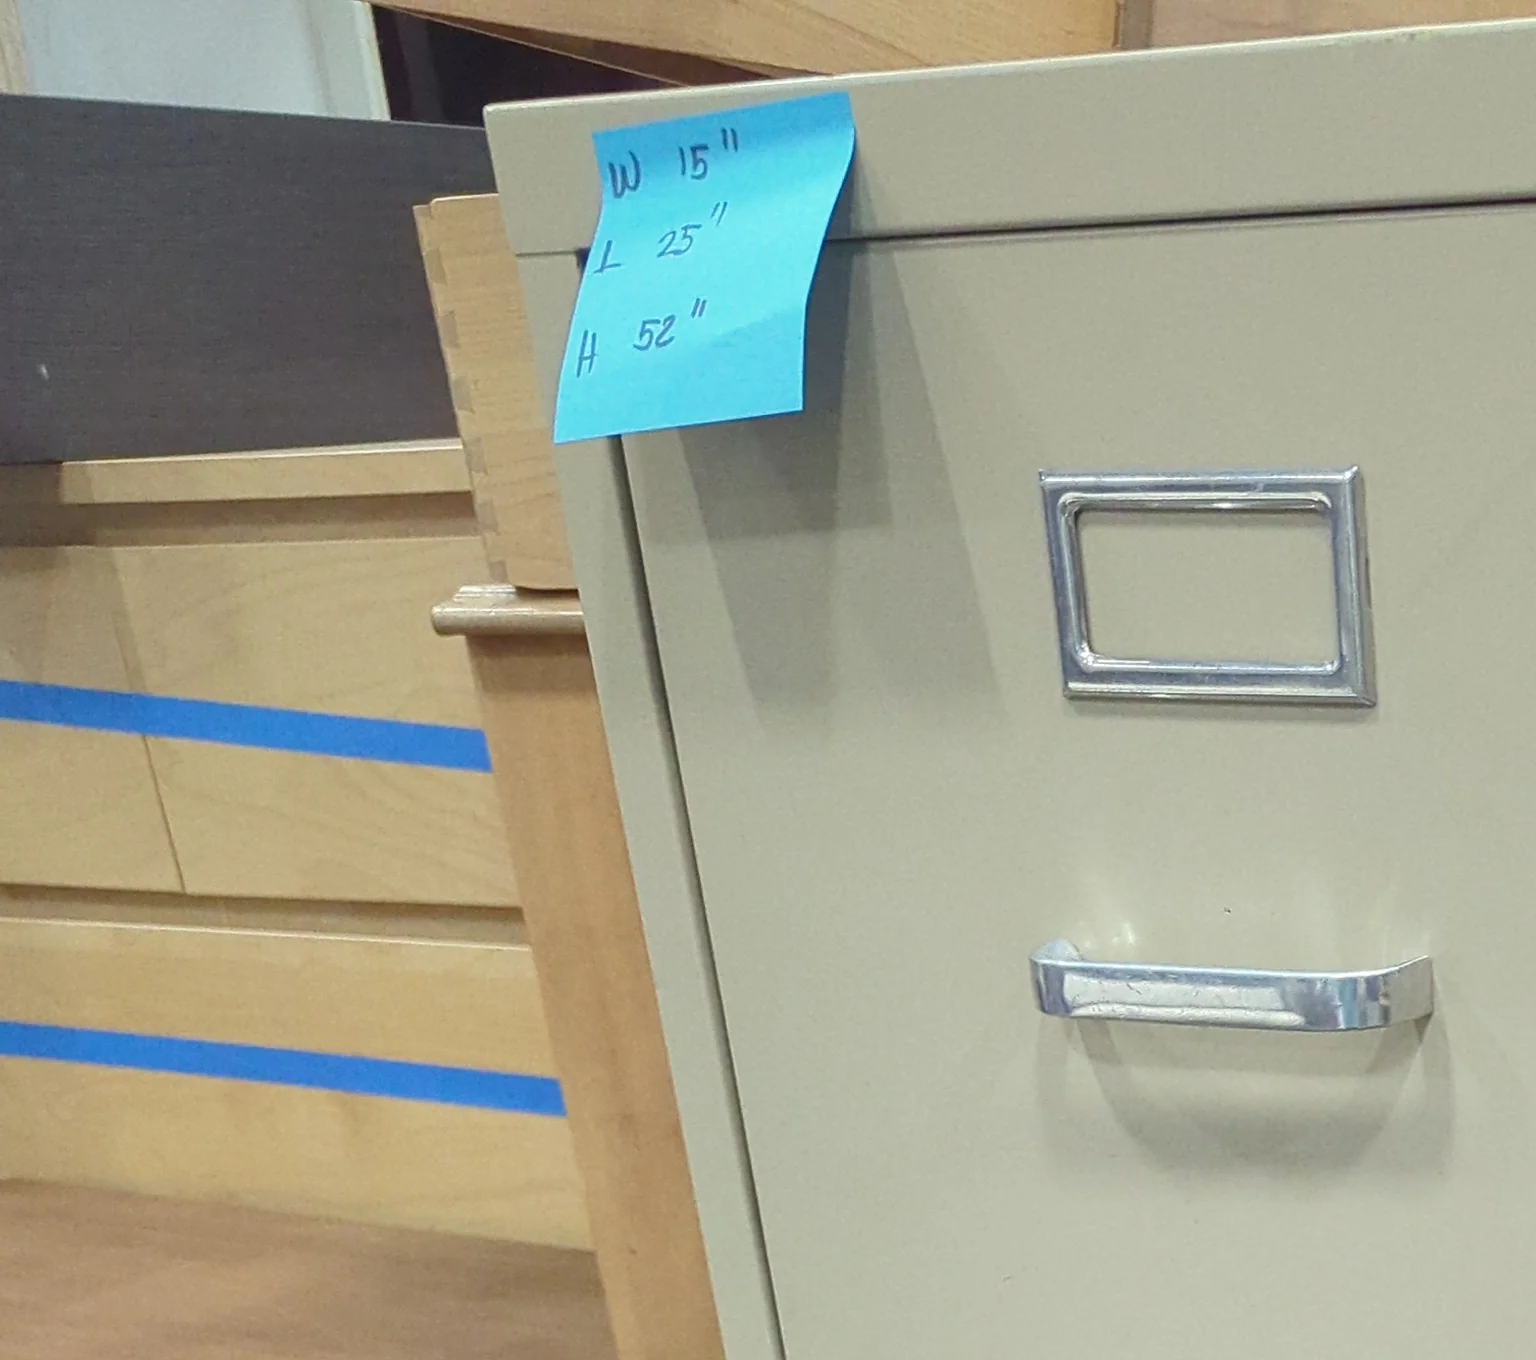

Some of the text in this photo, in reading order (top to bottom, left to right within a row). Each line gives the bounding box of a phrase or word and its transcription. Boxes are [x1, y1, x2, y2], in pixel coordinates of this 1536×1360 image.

[608, 128, 739, 198] W 15"
[594, 201, 728, 274] L 25"
[577, 298, 707, 377] H 52"
